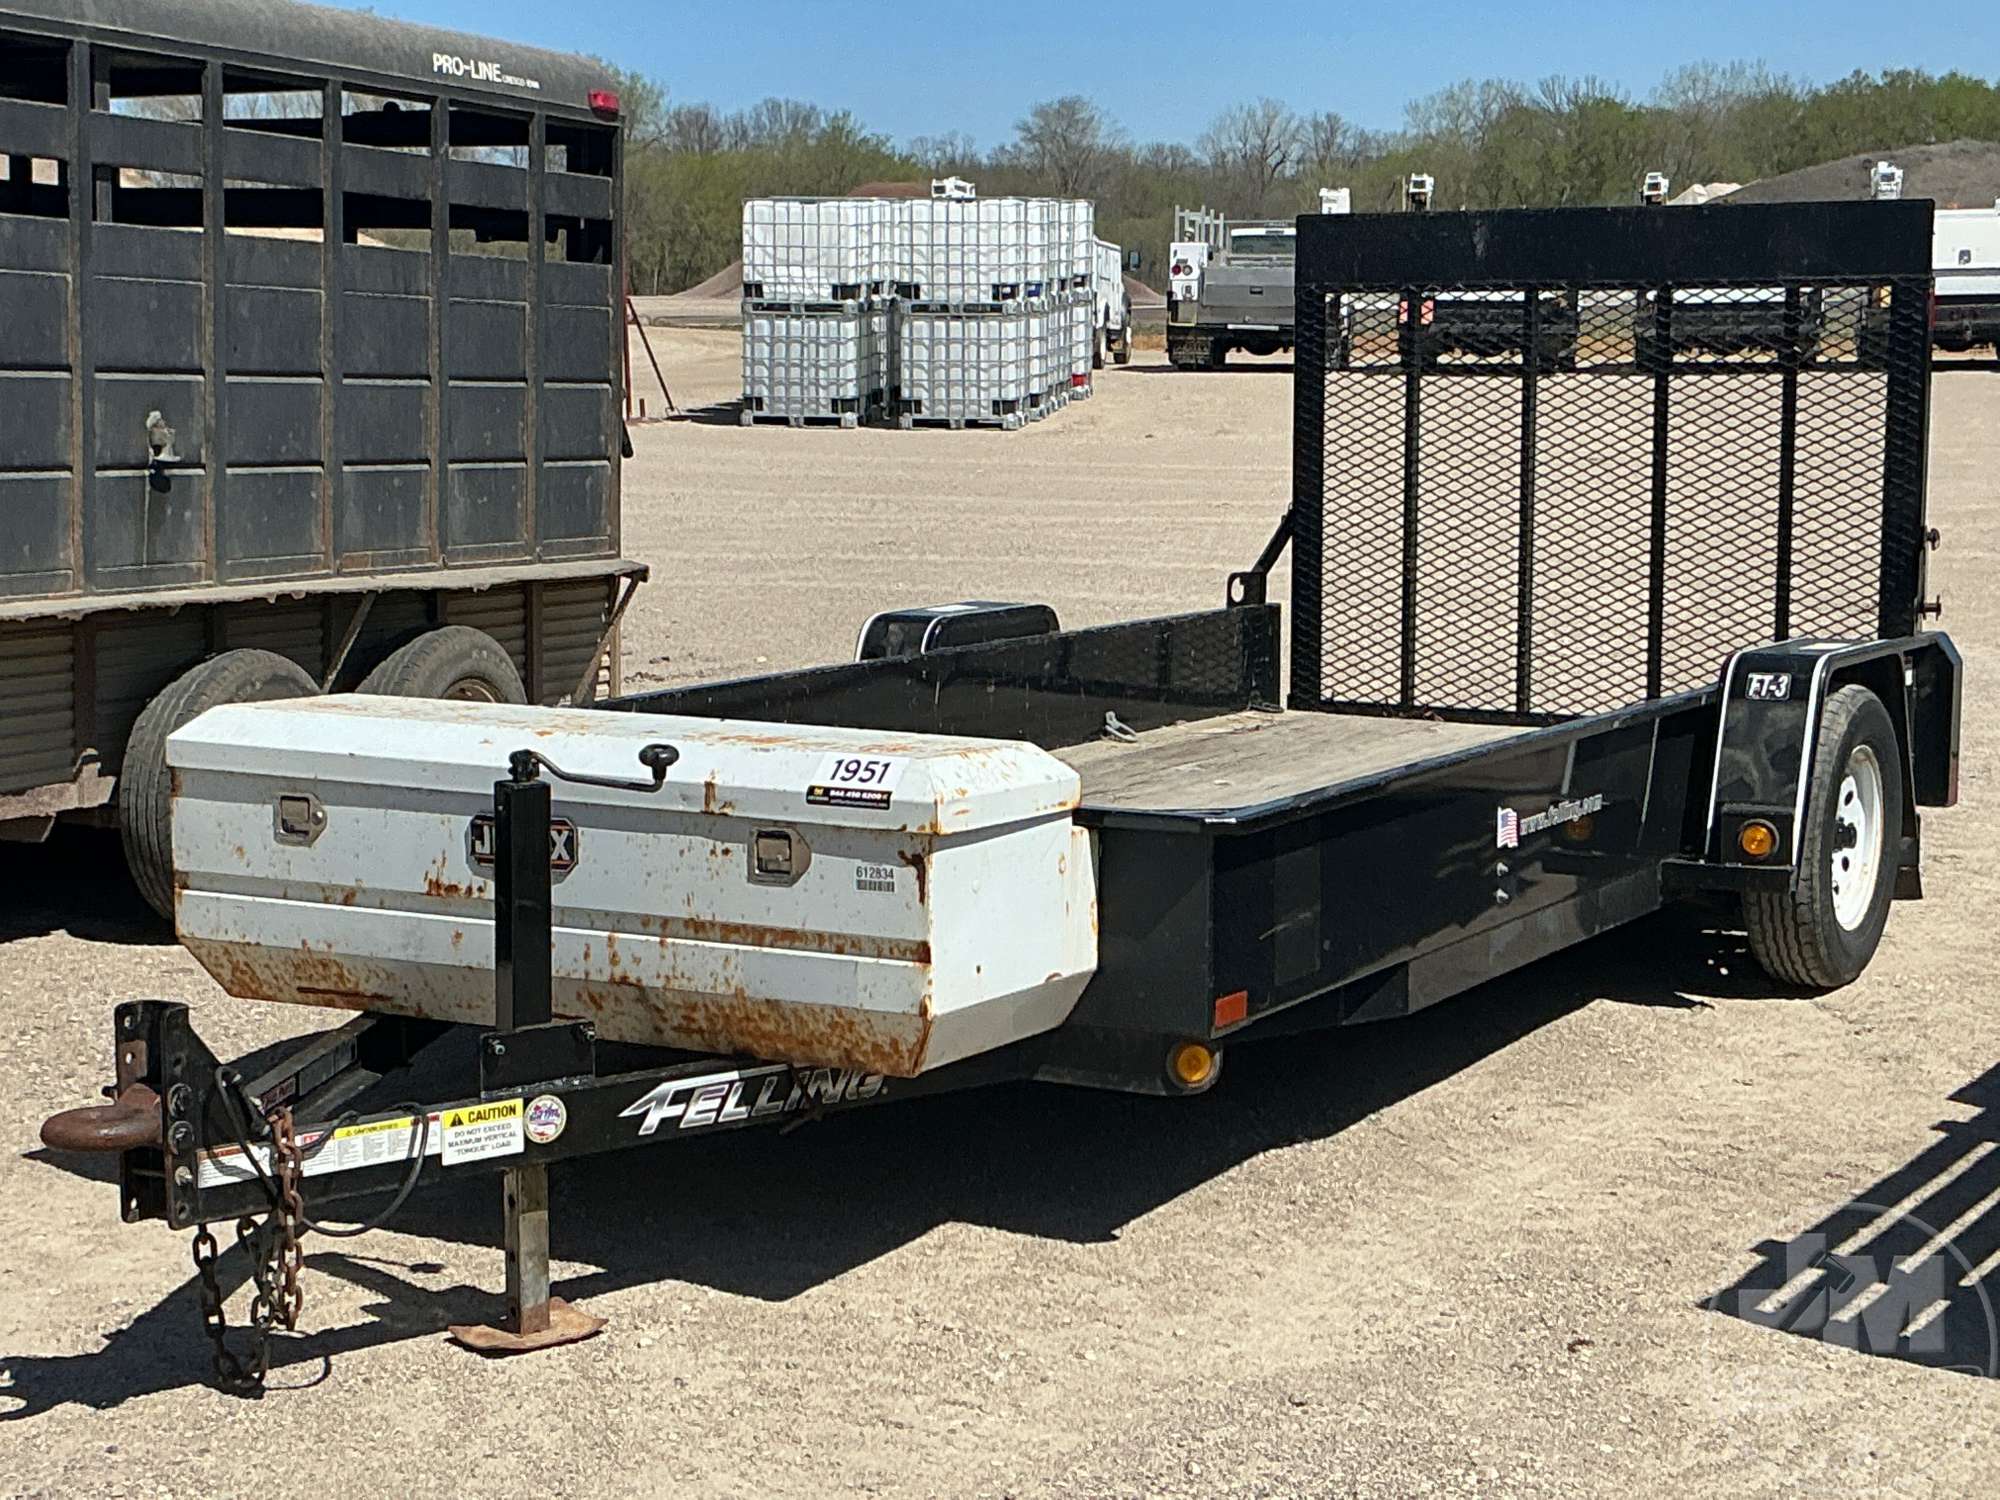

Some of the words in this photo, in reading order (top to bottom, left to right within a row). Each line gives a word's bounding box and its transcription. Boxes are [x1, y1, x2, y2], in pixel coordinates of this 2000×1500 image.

[432, 53, 502, 83] PRO-LINE
[1748, 674, 1789, 698] FT-3
[830, 758, 892, 784] 1951
[856, 866, 894, 880] 612834
[618, 1064, 886, 1136] FELLING
[468, 1104, 517, 1123] CAUTION
